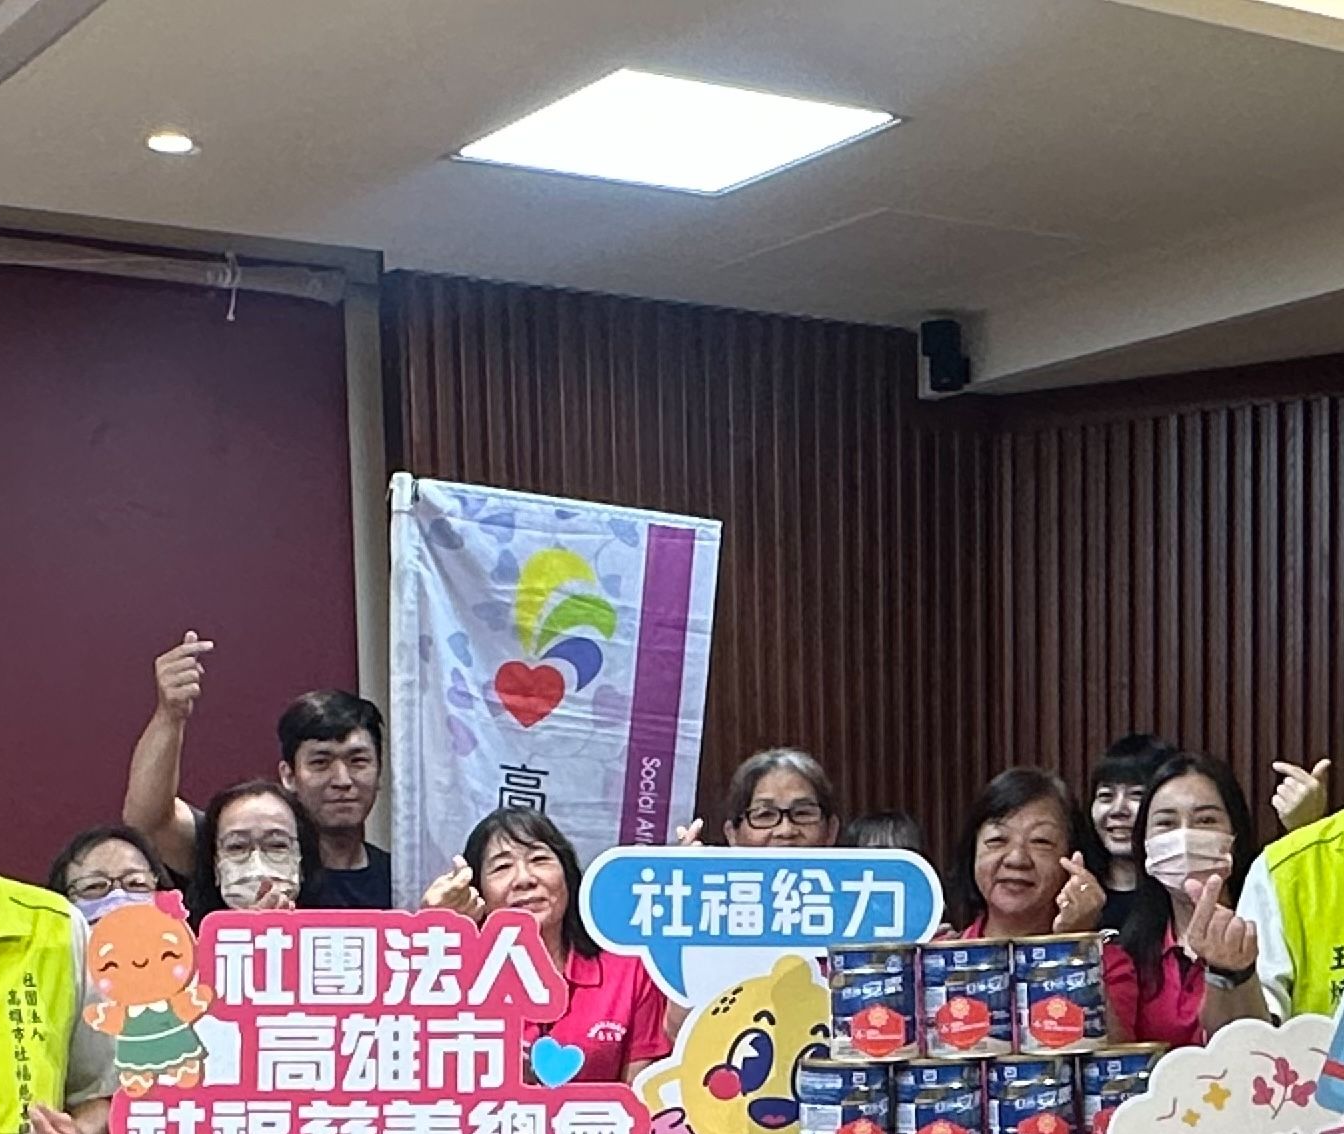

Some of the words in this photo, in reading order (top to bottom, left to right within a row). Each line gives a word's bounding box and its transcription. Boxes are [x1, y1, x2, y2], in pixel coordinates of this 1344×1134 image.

[637, 756, 662, 813] Social
[631, 868, 905, 937] 社福給力
[215, 927, 549, 1007] 社團法人
[256, 1014, 504, 1091] 高雄市
